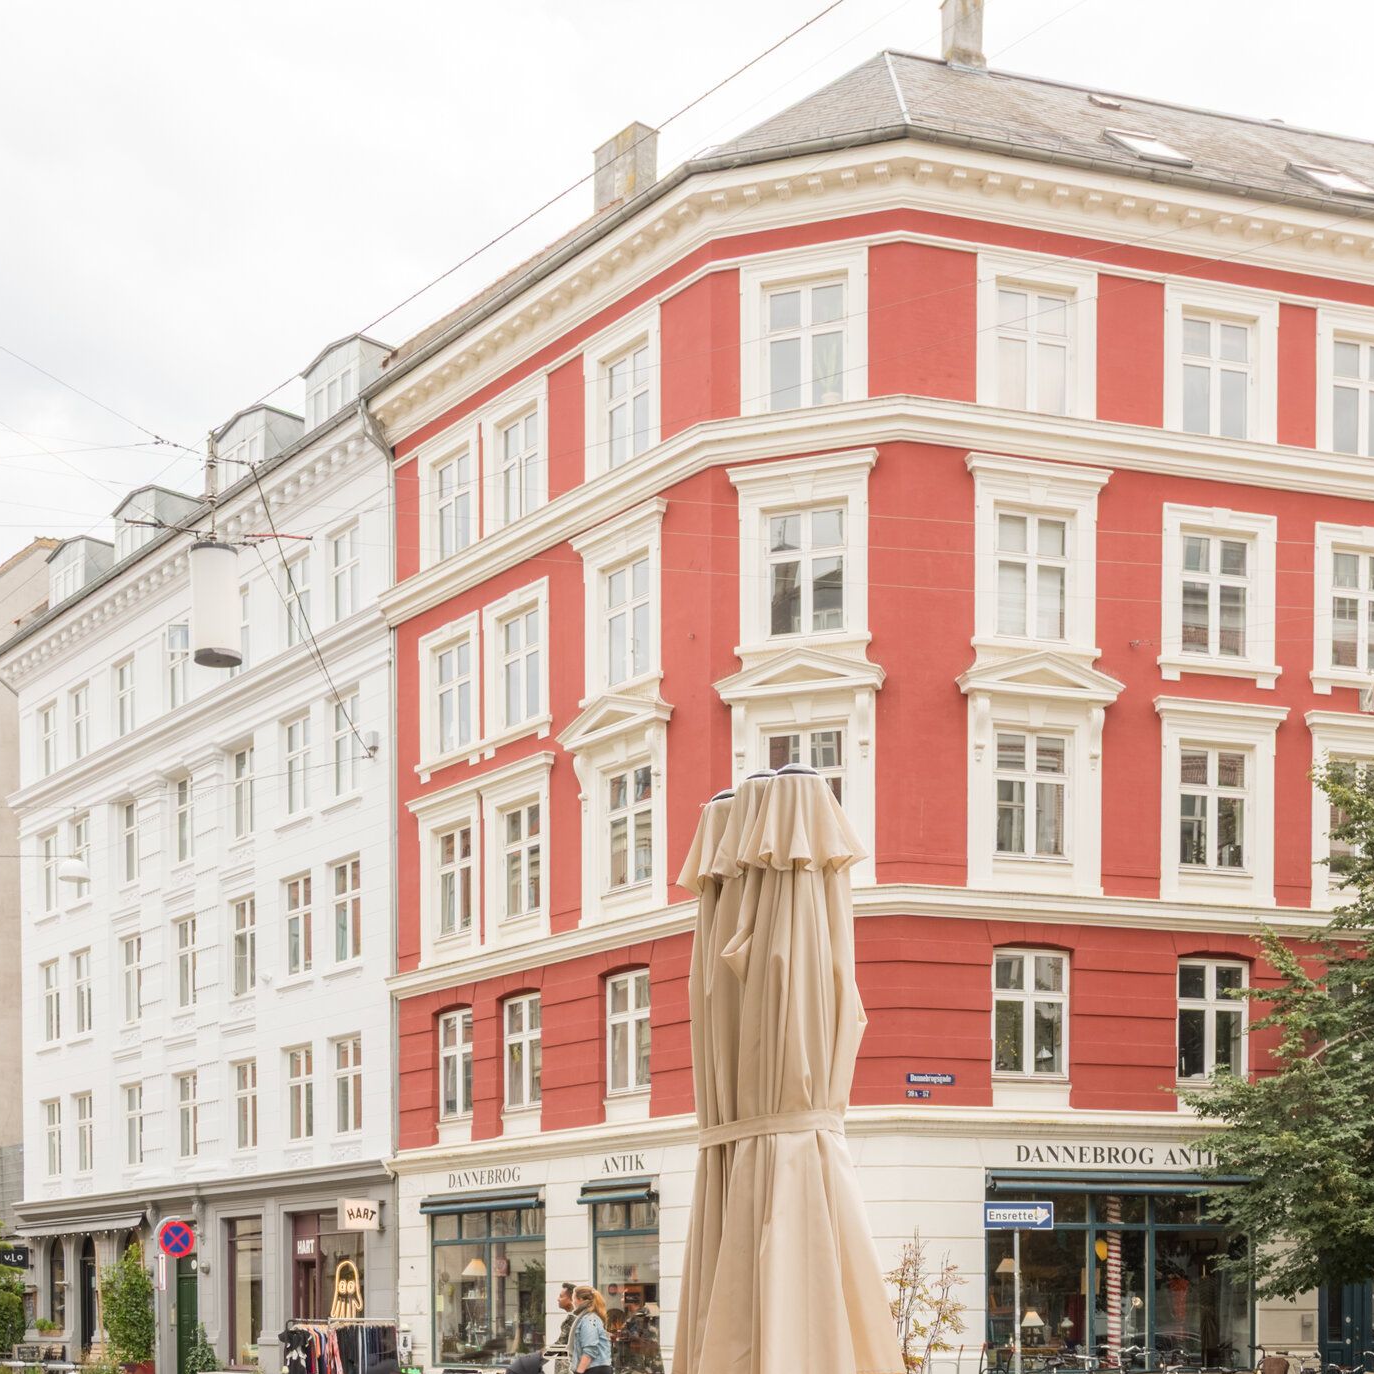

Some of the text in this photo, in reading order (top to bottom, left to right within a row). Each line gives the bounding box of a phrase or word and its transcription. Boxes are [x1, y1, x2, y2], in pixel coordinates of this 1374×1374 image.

[1016, 1144, 1154, 1165] DANNEBROG
[448, 1153, 645, 1188] DANNEBROG ANTIK
[346, 1207, 377, 1221] HART
[297, 1239, 315, 1255] HART
